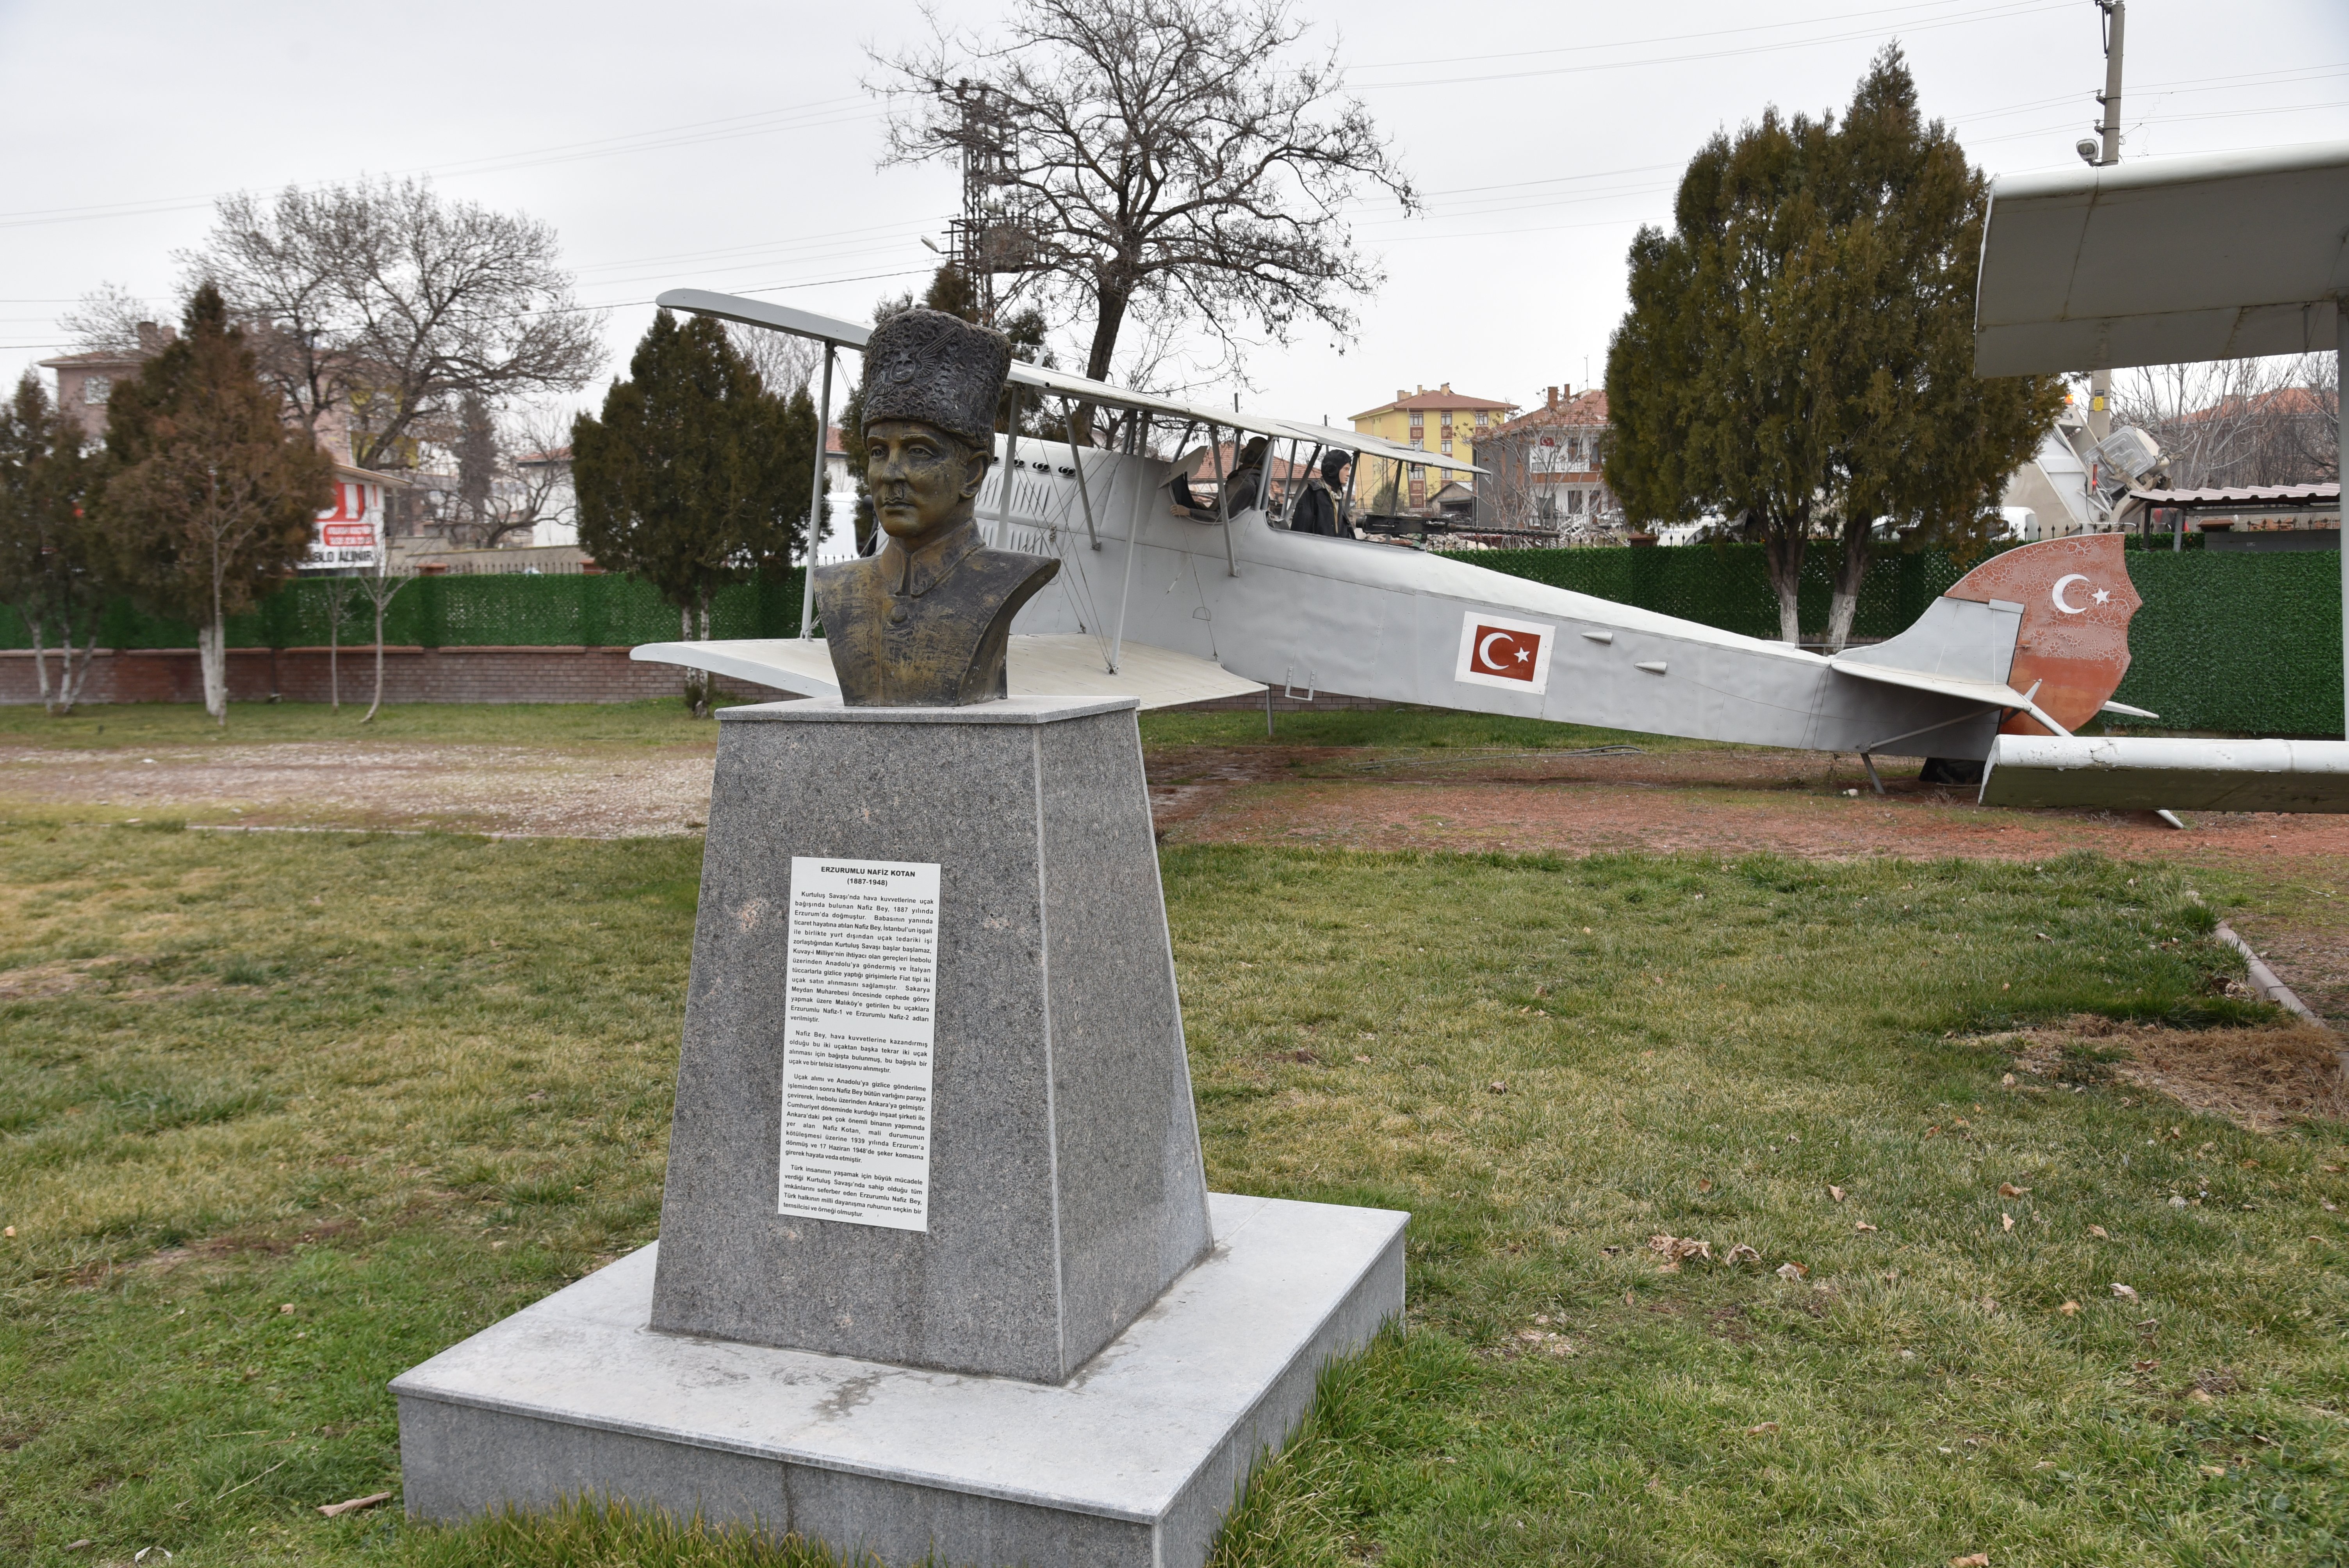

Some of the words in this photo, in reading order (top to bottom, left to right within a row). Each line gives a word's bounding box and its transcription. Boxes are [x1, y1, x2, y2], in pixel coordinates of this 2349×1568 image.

[821, 866, 865, 874] ERZURUMLU
[847, 878, 888, 887] (1887-1948)
[832, 912, 866, 920] doğmuştur.
[835, 941, 859, 950] Kurtuluş
[902, 946, 931, 954] başlamaz,
[863, 963, 896, 971] göndermiş
[910, 964, 930, 973] İtalyan
[862, 982, 897, 991] sağlamıştır.
[905, 985, 930, 993] Sakarya
[856, 1010, 886, 1018] Erzurumlu
[848, 1034, 886, 1043] kuvvetlerine
[889, 1038, 928, 1048] kazandırmış
[828, 1052, 849, 1060] bağışta
[852, 1054, 882, 1063] bulunmuş,
[895, 1058, 916, 1066] bağışla
[893, 1083, 926, 1092] gönderilme
[787, 1092, 814, 1101] çevirerek,
[816, 1094, 837, 1102] İnebolu
[787, 1101, 819, 1110] Cumhuriyet
[820, 1105, 852, 1113] döneminde
[854, 1108, 878, 1117] kurduğu
[786, 1130, 822, 1139] kötüleşmesi
[841, 1126, 860, 1134] Kotan,
[889, 1131, 924, 1140] durumunun
[785, 1139, 808, 1148] dönmüş
[895, 1151, 923, 1160] komasına
[806, 1166, 831, 1174] insanının
[806, 1176, 831, 1185] Kurtuluş
[887, 1186, 907, 1194] olduğu
[798, 1194, 820, 1202] halkının
[834, 1199, 865, 1207] dayanışma
[783, 1202, 809, 1210] temsilcisi
[818, 1206, 836, 1215] örneği
[836, 1209, 863, 1217] olmuştur.
